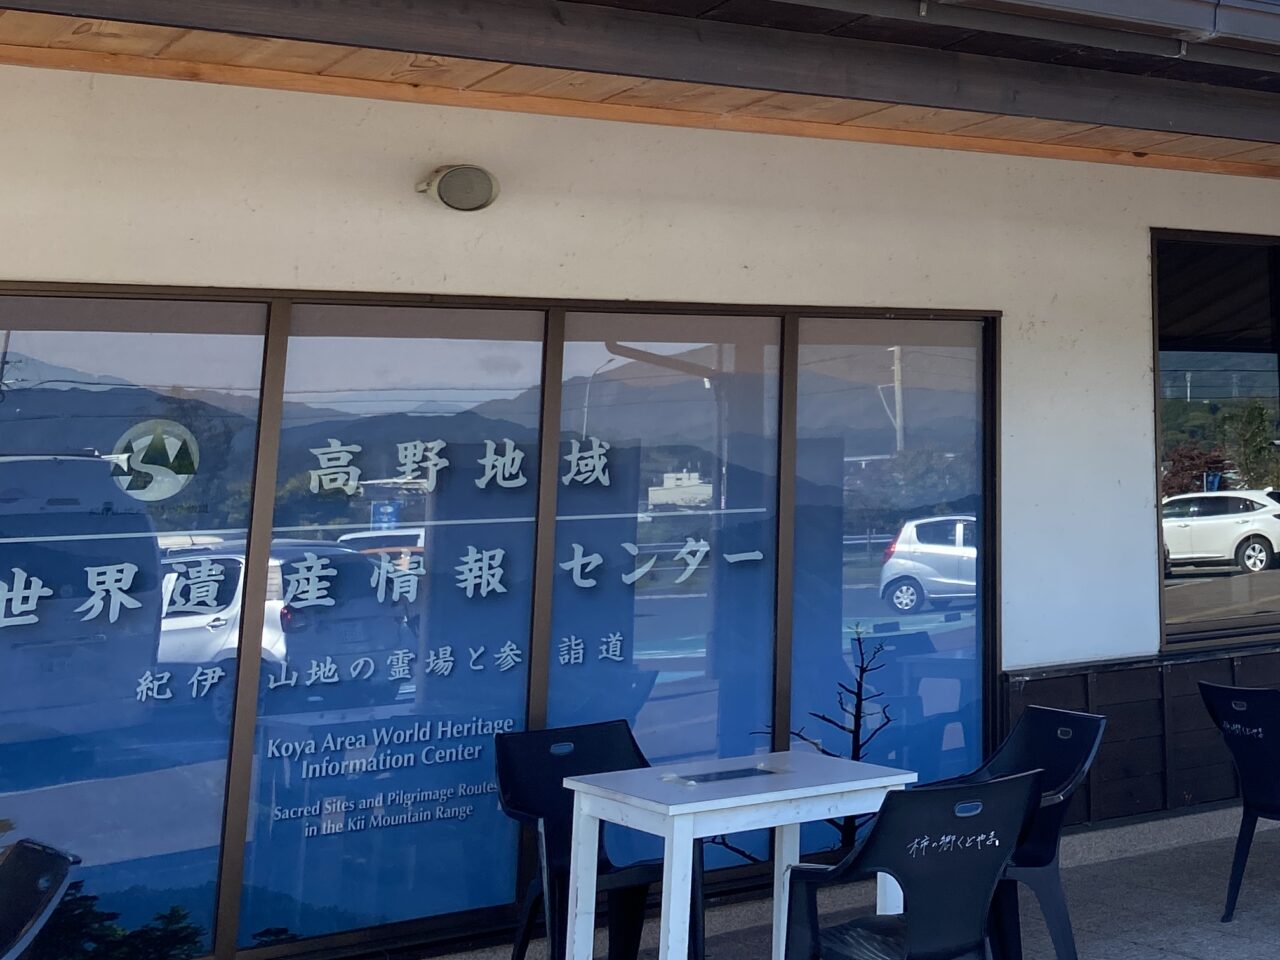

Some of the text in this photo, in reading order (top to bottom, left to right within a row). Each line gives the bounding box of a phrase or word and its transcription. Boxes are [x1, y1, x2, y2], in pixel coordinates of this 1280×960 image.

[308, 438, 612, 496] 高野地域
[0, 537, 764, 628] 世界遺産情報センター
[267, 716, 514, 761] Koya Area World Heritage
[301, 744, 482, 779] Information Center
[273, 801, 320, 821] Sacred
[324, 799, 355, 815] Sites
[359, 793, 383, 809] and
[387, 785, 454, 808] Pilgrimage
[305, 804, 474, 838] in the Kii Mountain Range
